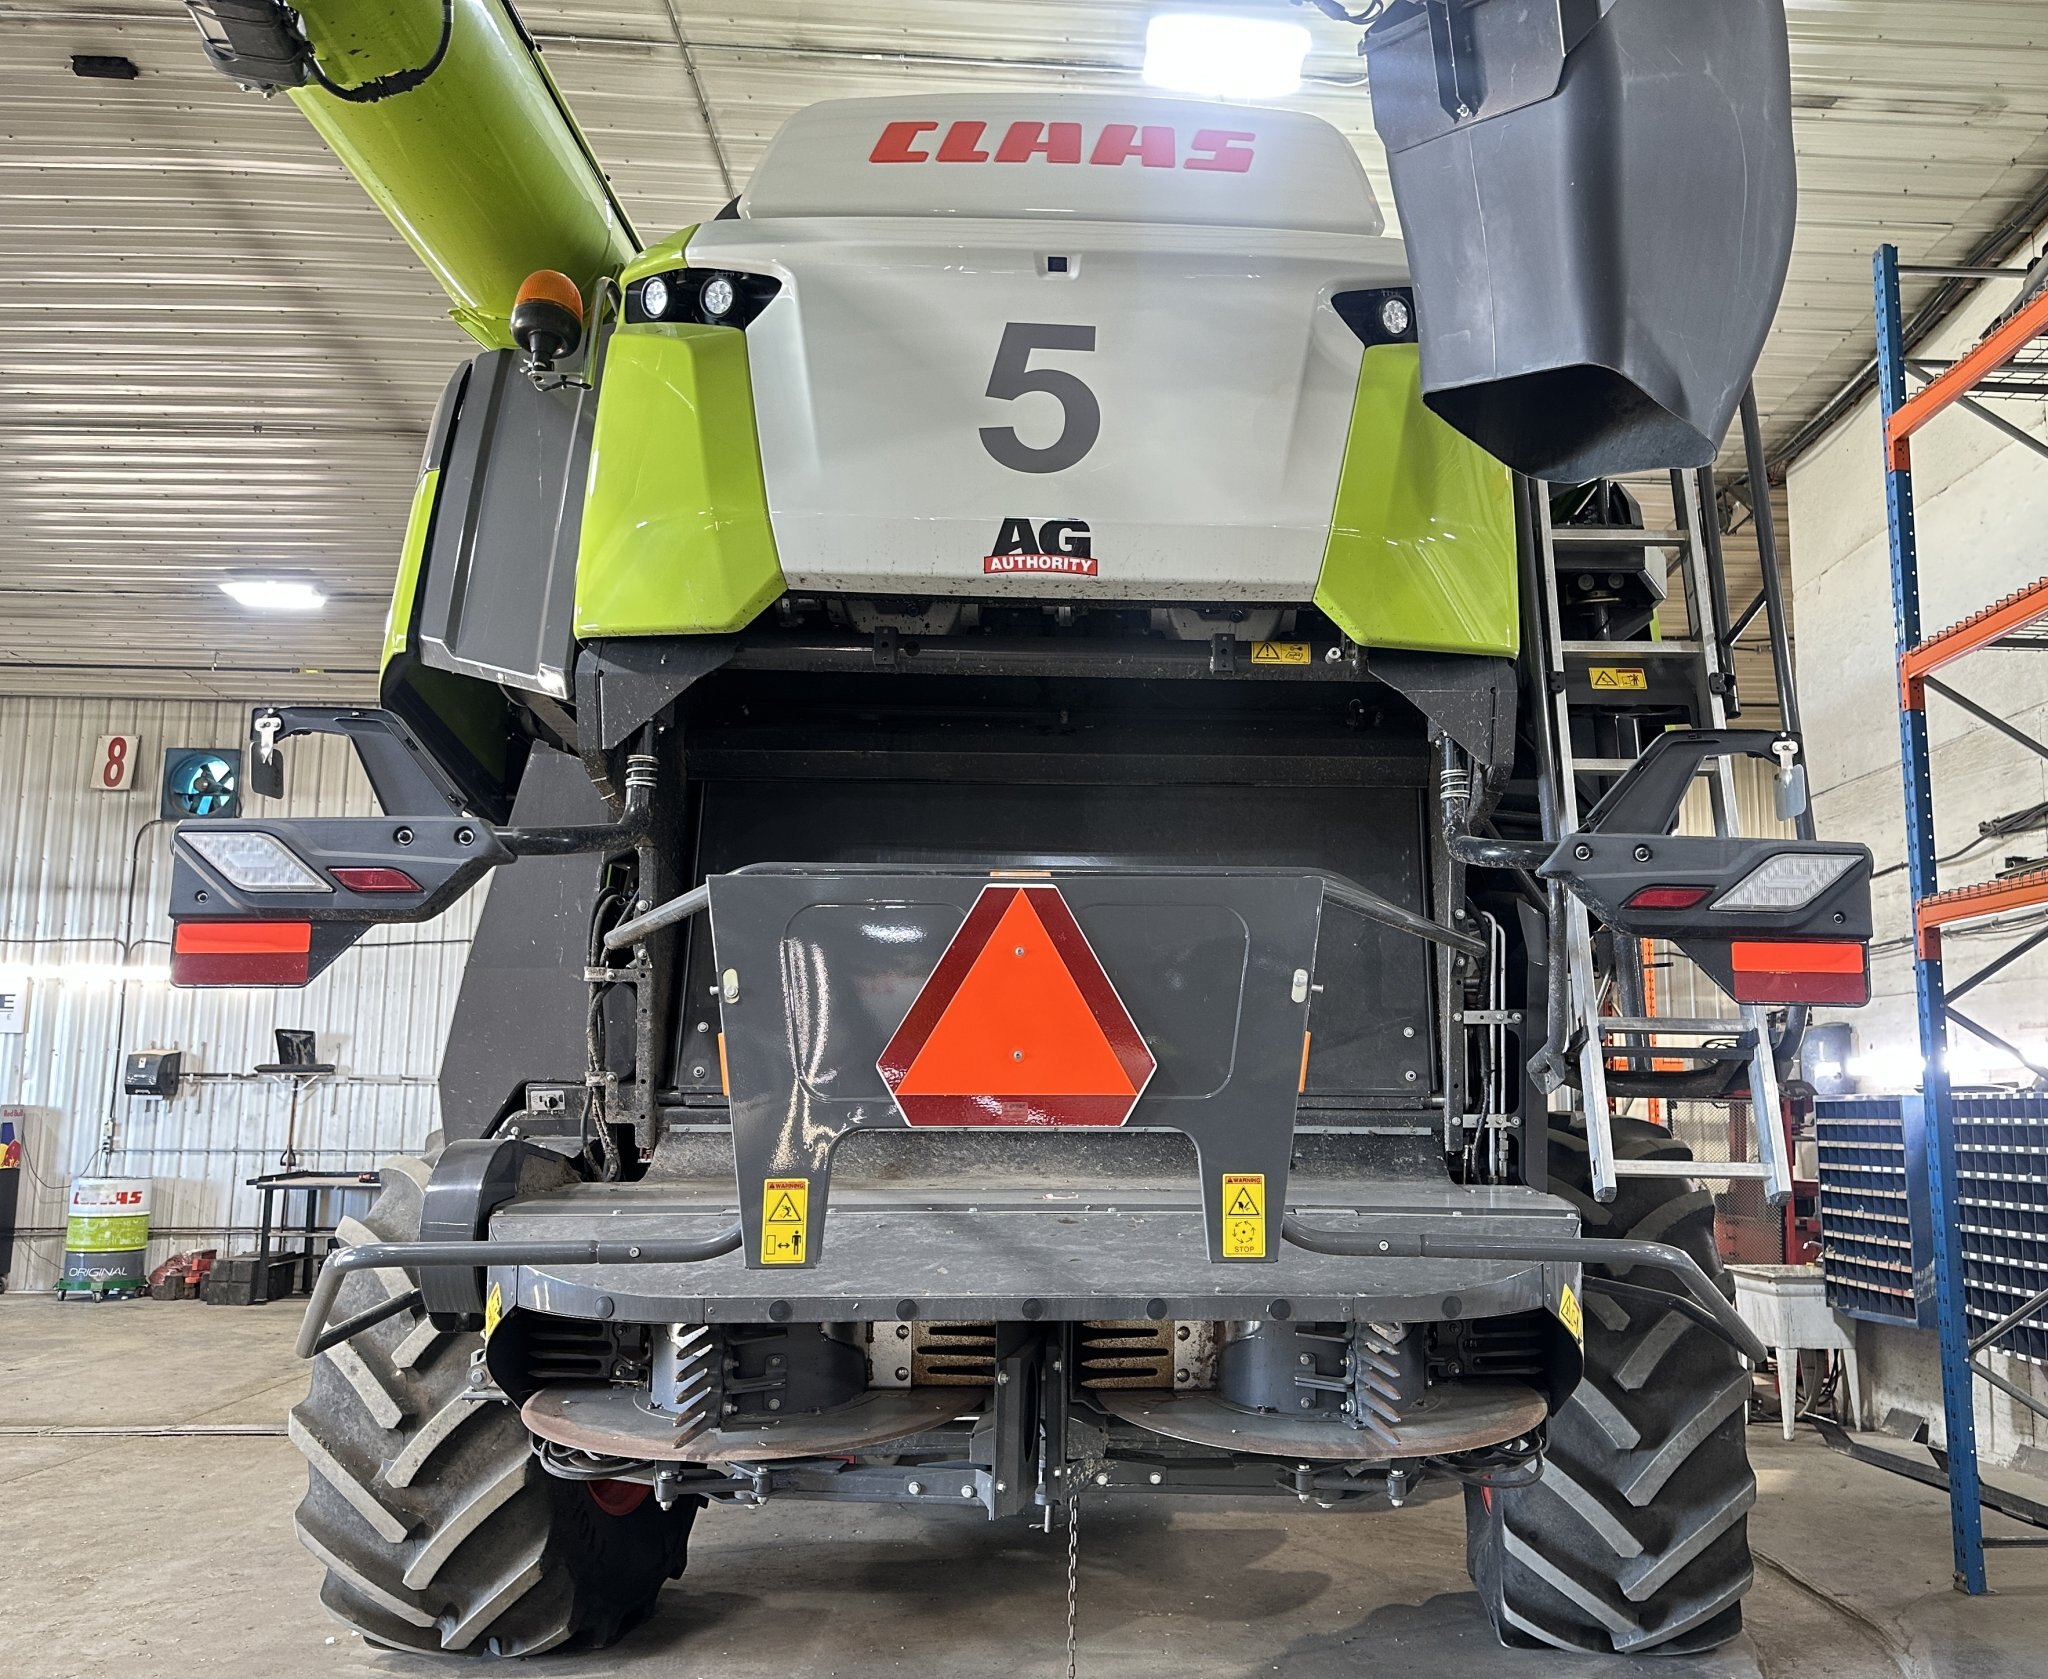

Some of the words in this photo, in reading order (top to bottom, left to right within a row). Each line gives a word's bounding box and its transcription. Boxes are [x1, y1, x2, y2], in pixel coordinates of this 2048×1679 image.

[869, 121, 1256, 173] CLAAS
[978, 322, 1101, 474] 5
[991, 517, 1092, 558] AG
[990, 556, 1093, 572] AUTHORITY
[103, 736, 127, 788] 8
[68, 1267, 128, 1277] ORIGINAL
